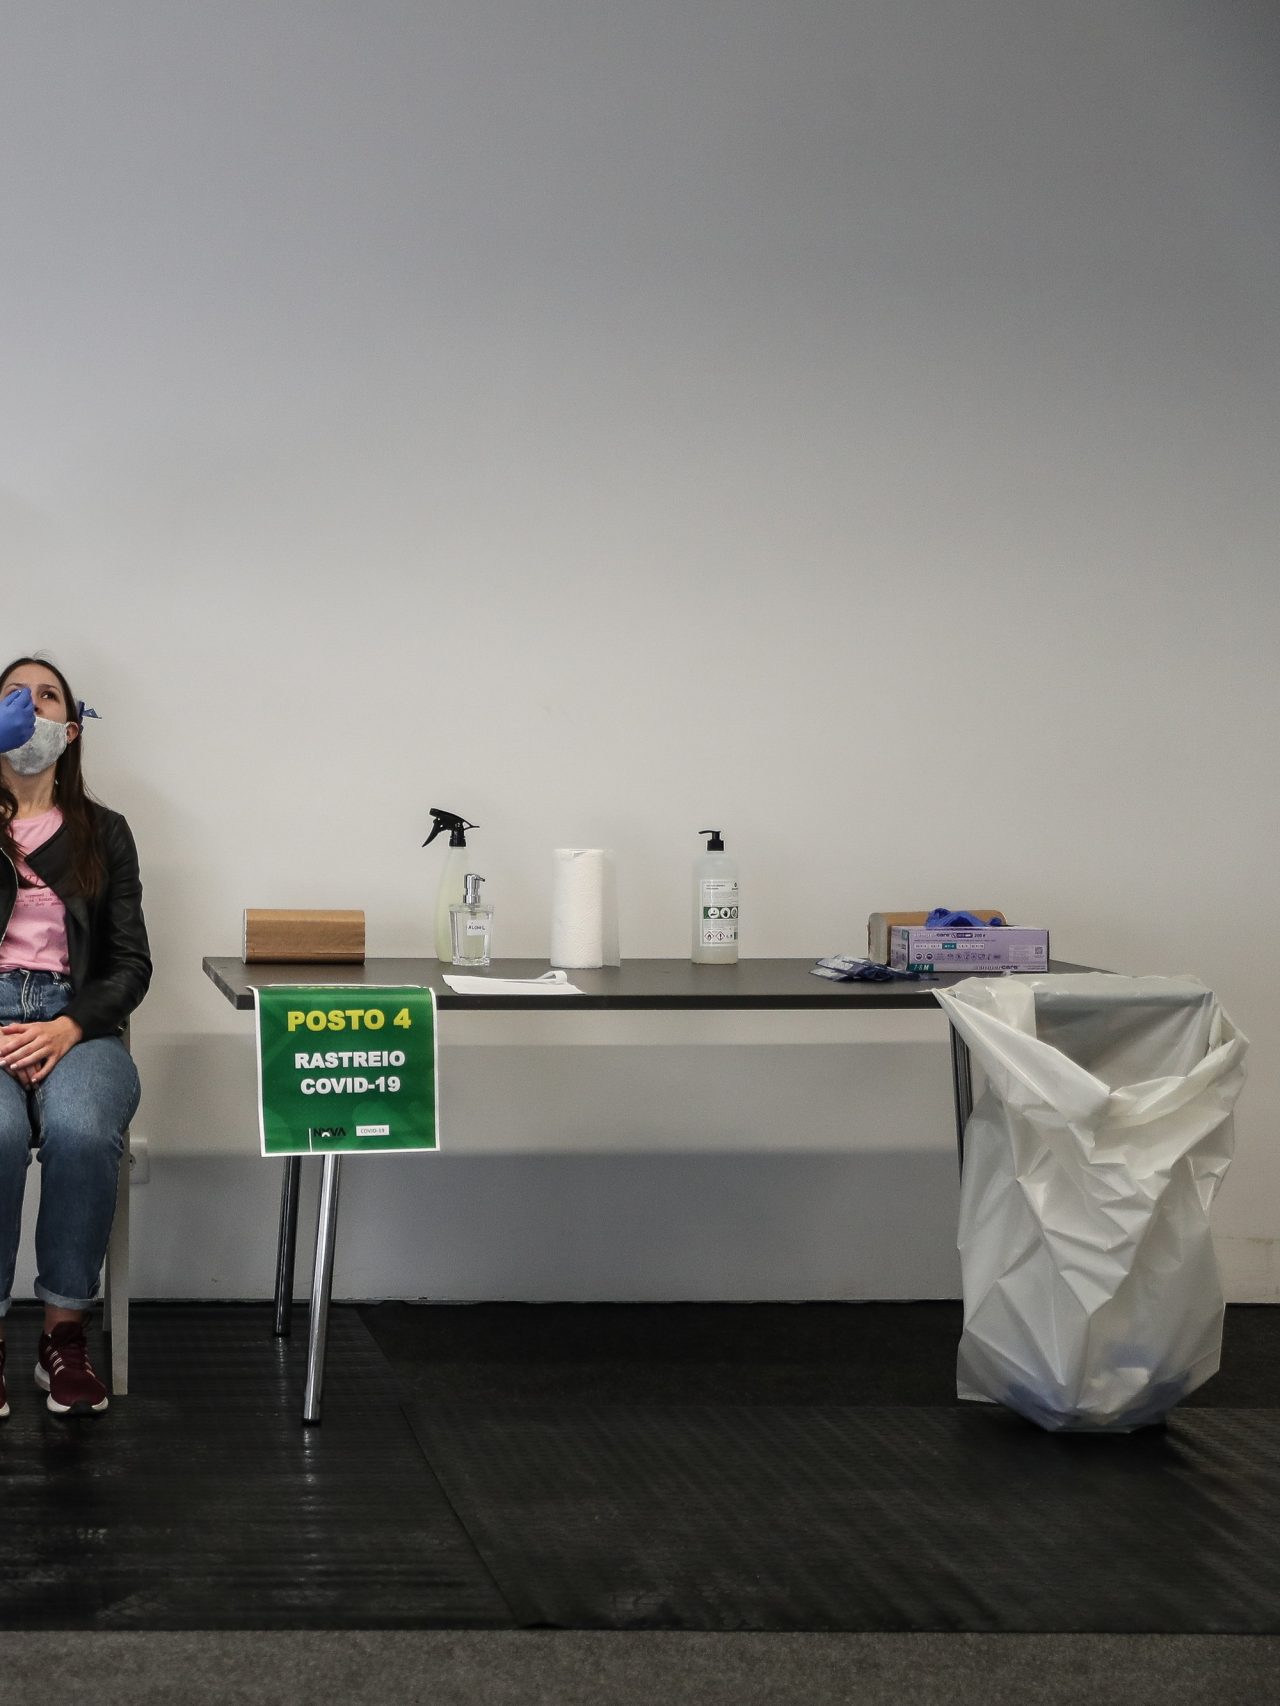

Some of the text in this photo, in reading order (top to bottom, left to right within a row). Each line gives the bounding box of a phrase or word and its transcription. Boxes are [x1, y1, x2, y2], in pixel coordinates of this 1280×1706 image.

[287, 1008, 412, 1032] POSTO 4
[294, 1050, 406, 1069] RASTREIO
[300, 1076, 401, 1095] COVID-19
